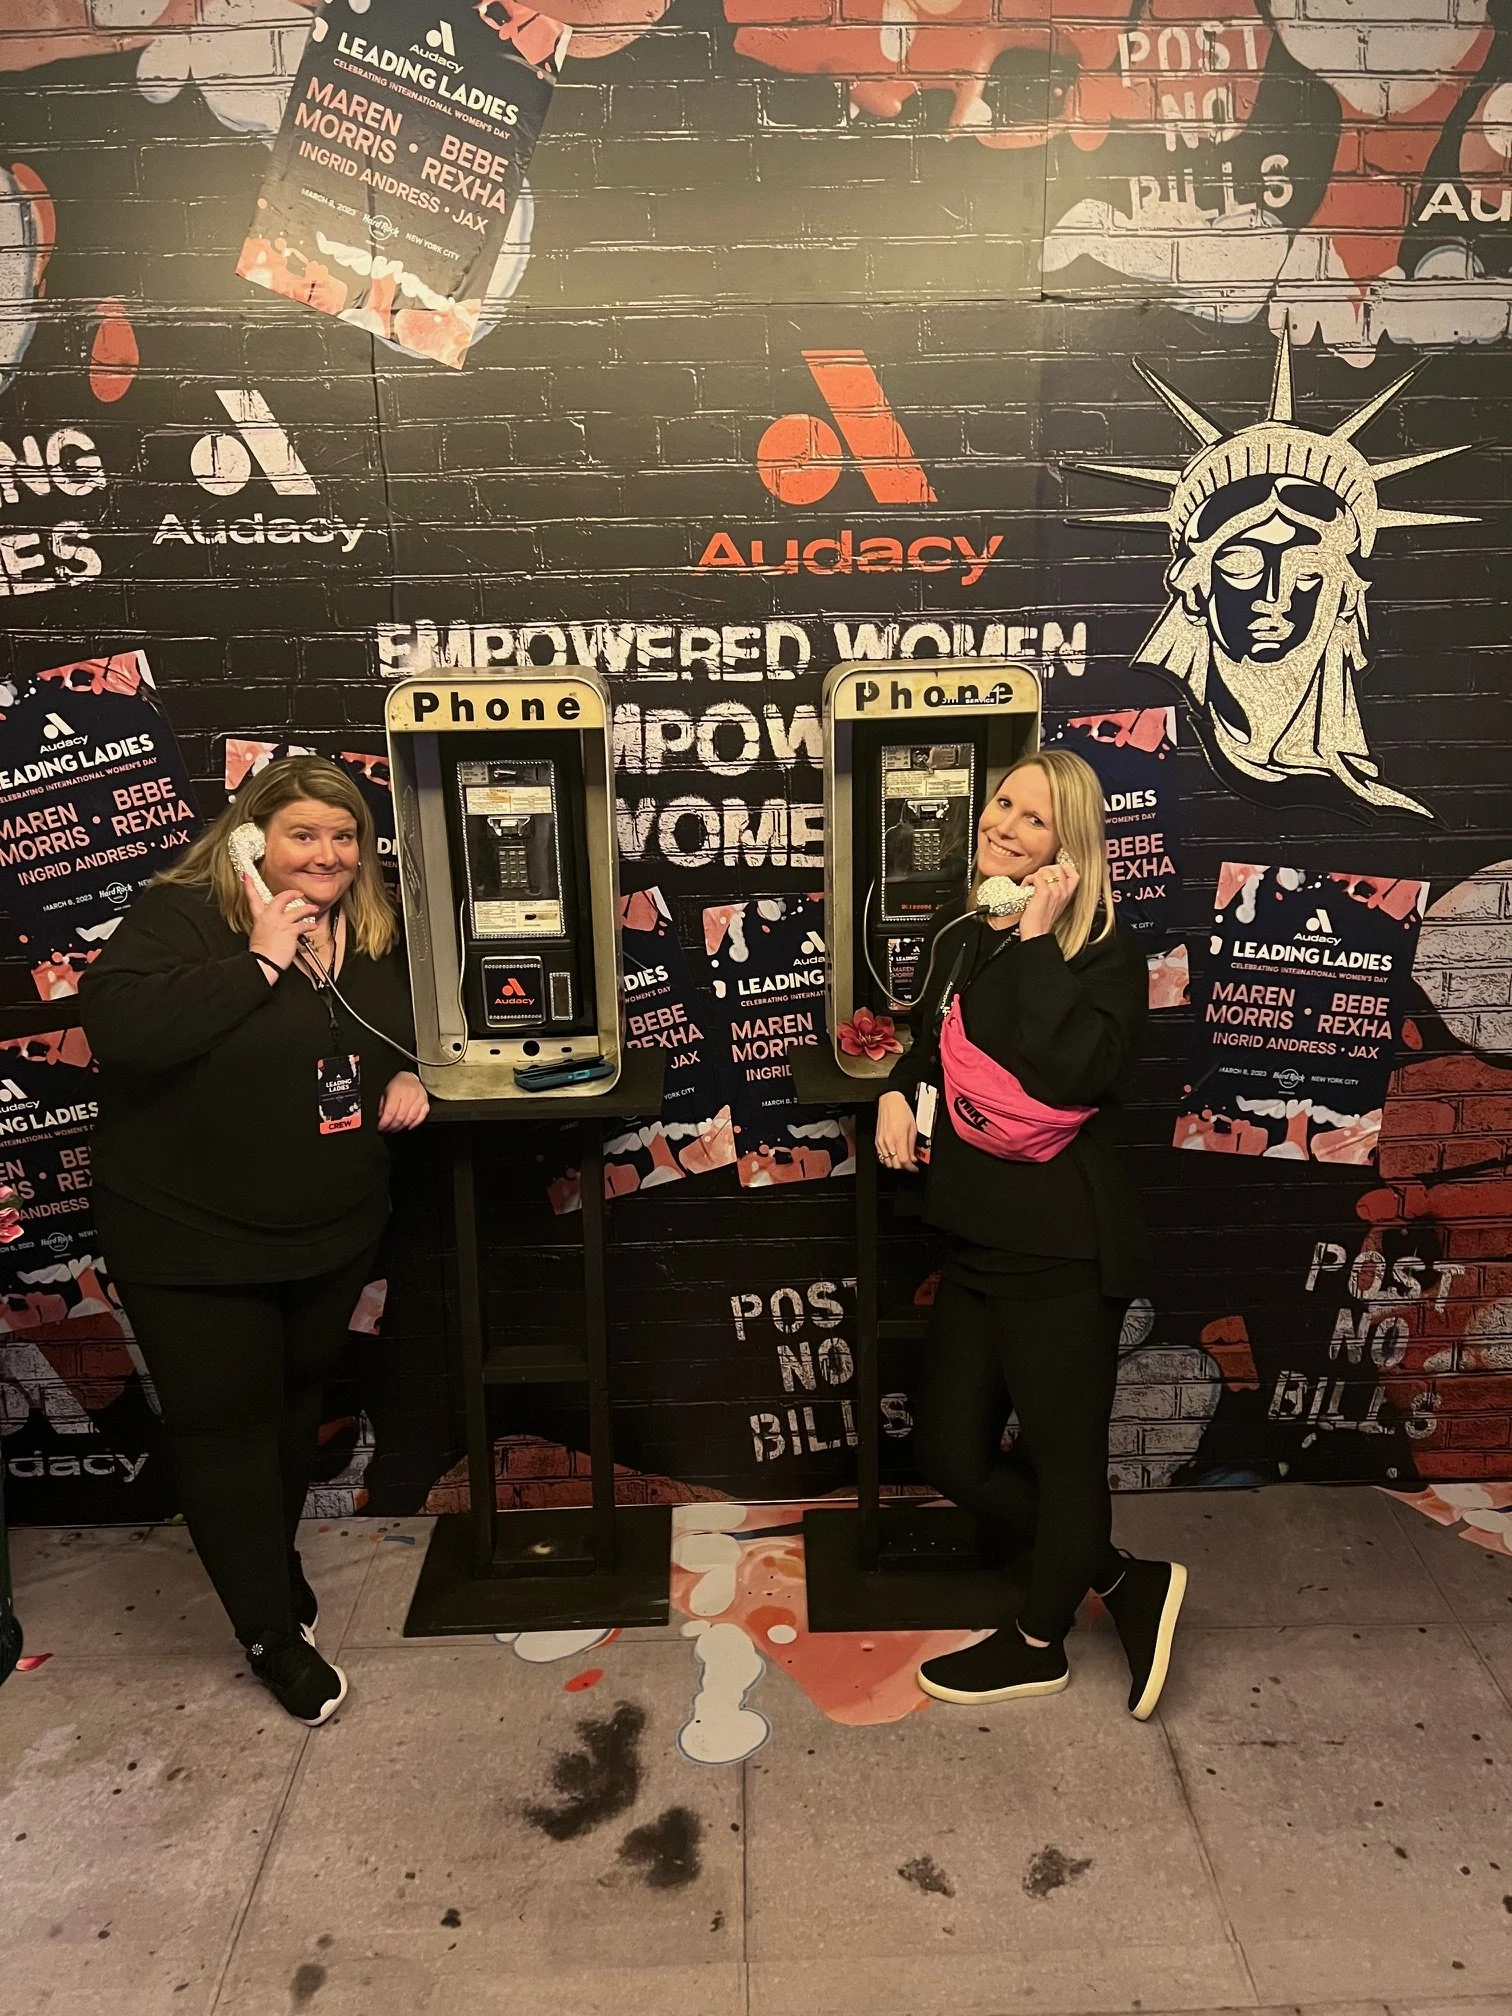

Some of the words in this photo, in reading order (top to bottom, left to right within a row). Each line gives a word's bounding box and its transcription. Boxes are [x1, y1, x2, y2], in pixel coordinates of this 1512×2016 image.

[409, 43, 465, 74] Audacy
[1118, 23, 1260, 87] POST
[337, 32, 437, 90] LEADING
[438, 76, 520, 126] LADIES
[306, 77, 403, 136] MAREN
[332, 58, 388, 87] CELEBRATING
[388, 81, 453, 116] INTERNATIONAL
[454, 109, 493, 133] WOMEN'S
[493, 126, 511, 140] DAY
[1161, 86, 1235, 151] NO
[294, 103, 397, 165] MORRIS
[440, 134, 509, 183] BEBE
[298, 140, 358, 177] INGRID
[358, 168, 441, 213] ANDRESS
[452, 209, 489, 235] JAX
[300, 188, 328, 205] MARCH
[420, 157, 507, 214] REXHA
[1417, 182, 1512, 222] Au
[405, 232, 424, 246] NEW
[423, 238, 443, 255] YORK
[442, 247, 461, 262] CITY
[152, 513, 370, 553] Audacy
[698, 529, 1004, 587] Audacy
[376, 619, 812, 681] EMPOWERED
[833, 621, 1087, 678] WOMEN
[413, 691, 581, 722] Phone
[855, 681, 1014, 712] Phone
[40, 734, 89, 754] Audacy
[0, 755, 78, 792] EADING
[82, 733, 154, 769] LADIES
[0, 786, 45, 804] ELEBRATING
[45, 769, 106, 793] INTERNATIONAL
[105, 761, 142, 776] WOMEN'S
[143, 756, 157, 767] DAY
[112, 777, 176, 811] BEBE
[0, 802, 79, 841] MAREN
[110, 800, 195, 837] REXHA
[1105, 814, 1140, 824] WOMEN'S
[1141, 812, 1157, 820] DAY
[0, 826, 90, 867] MORRIS
[18, 860, 72, 887] INGRID
[75, 841, 148, 873] ANDRESS
[159, 829, 191, 851] JAX
[1105, 832, 1164, 860] BEBE
[1110, 855, 1176, 882] EXHA
[43, 900, 67, 912] MARCH
[76, 893, 93, 904] 2023
[1135, 884, 1167, 901] JAX
[1138, 921, 1155, 930] CITY
[1293, 932, 1342, 946] Audacy
[793, 956, 825, 967] Auda
[1232, 940, 1320, 965] LEADING
[1322, 949, 1393, 972] LADIES
[623, 965, 669, 993] DIES
[738, 969, 825, 996] LEADING
[1230, 961, 1280, 974] CELEBRATING
[1280, 966, 1338, 980] INTERNATIONAL
[1338, 972, 1373, 983] WOMEN'S
[1374, 975, 1389, 984] DAY
[494, 997, 535, 1006] Audacy
[657, 986, 671, 995] DAY
[740, 994, 789, 1008] CELEBRATING
[1211, 982, 1295, 1008] MAREN
[1205, 1005, 1294, 1030] MORRIS
[1331, 993, 1390, 1017] BEBE
[628, 1003, 688, 1036] BEBE
[731, 1012, 813, 1041] MAREN
[1317, 1014, 1393, 1040] REXHA
[671, 1050, 700, 1070] JAX
[1212, 1032, 1264, 1049] INGRID
[1266, 1037, 1337, 1056] ANDRESS
[1348, 1045, 1380, 1060] JAX
[325, 1078, 352, 1088] LEADING
[1218, 1066, 1242, 1075] MARCH
[1311, 1075, 1327, 1083] NEW
[1326, 1076, 1344, 1085] YORK
[328, 1084, 350, 1093] LADIES
[664, 1088, 680, 1100] YORK
[680, 1086, 695, 1096] CITY
[0, 1100, 40, 1114] udacy
[29, 1101, 99, 1130] LADIES
[761, 1099, 785, 1107] MARCH
[54, 1125, 89, 1136] WOMEN'S
[328, 1120, 352, 1130] CREW
[20, 1197, 90, 1221] ANDRESS
[1304, 1241, 1466, 1314] POST
[1329, 1308, 1410, 1367] NO
[777, 1337, 855, 1392] NO
[1268, 1370, 1442, 1440] BILLS
